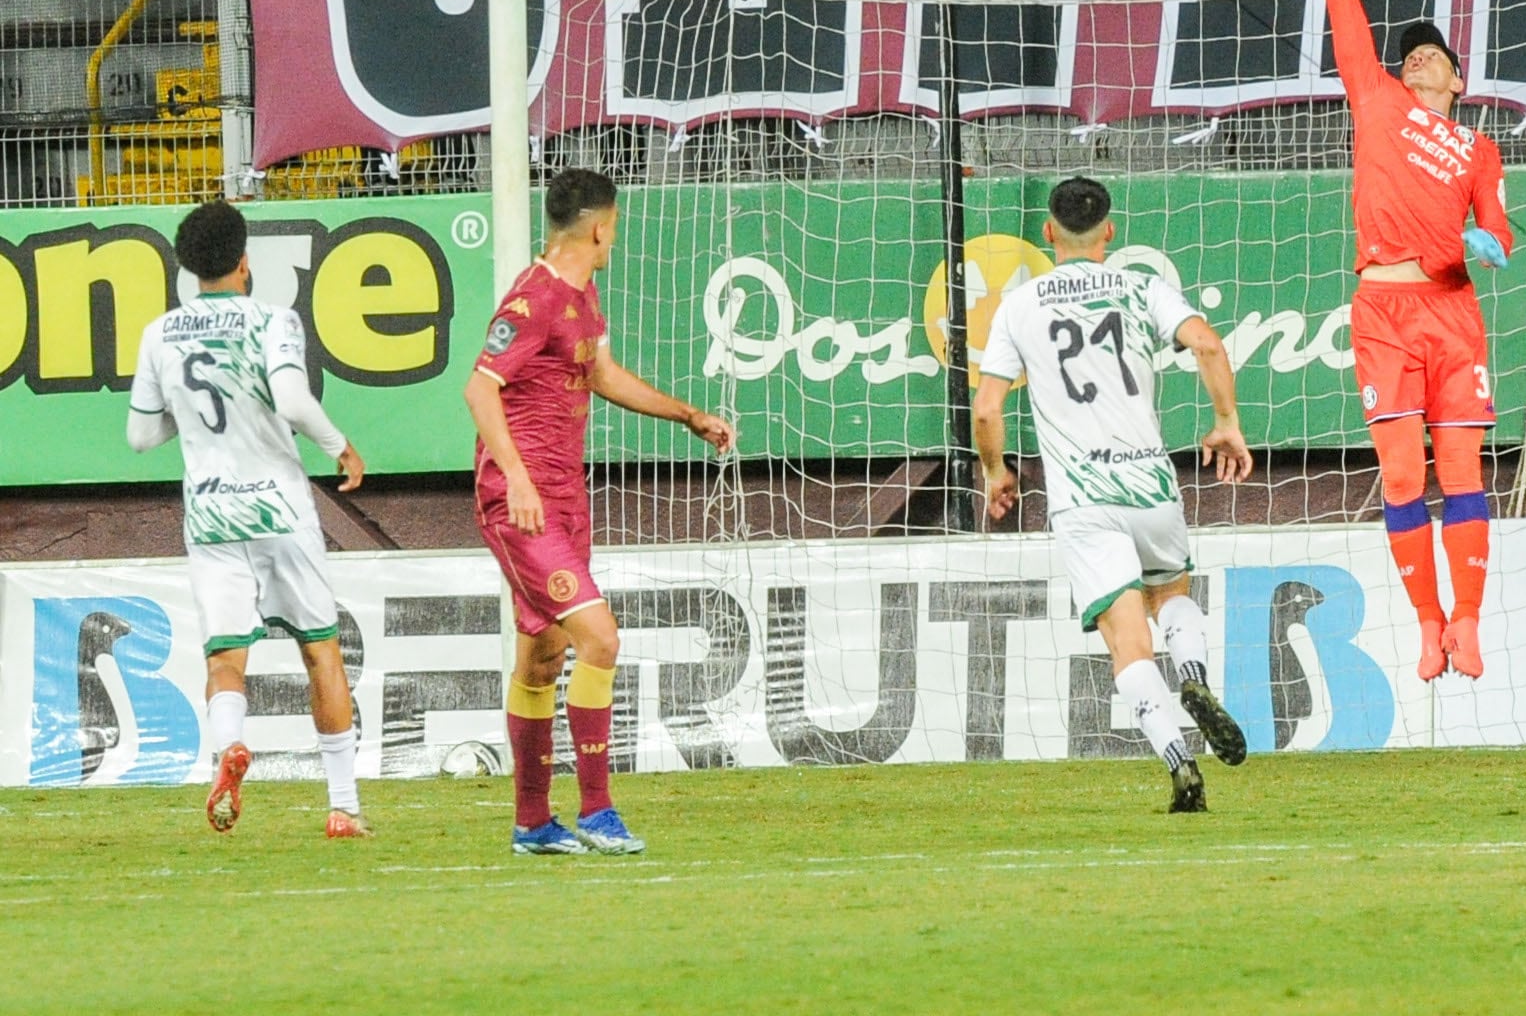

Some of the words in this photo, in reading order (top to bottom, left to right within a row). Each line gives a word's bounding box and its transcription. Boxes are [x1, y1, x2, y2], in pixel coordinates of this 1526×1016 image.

[1401, 127, 1467, 177] LIBERTY
[1432, 122, 1474, 162] BAC
[1037, 273, 1124, 298] CARMELITA
[163, 312, 246, 334] CARMELITA
[703, 255, 940, 384] Dos
[1049, 311, 1140, 404] 21
[194, 477, 278, 496] MONARCA
